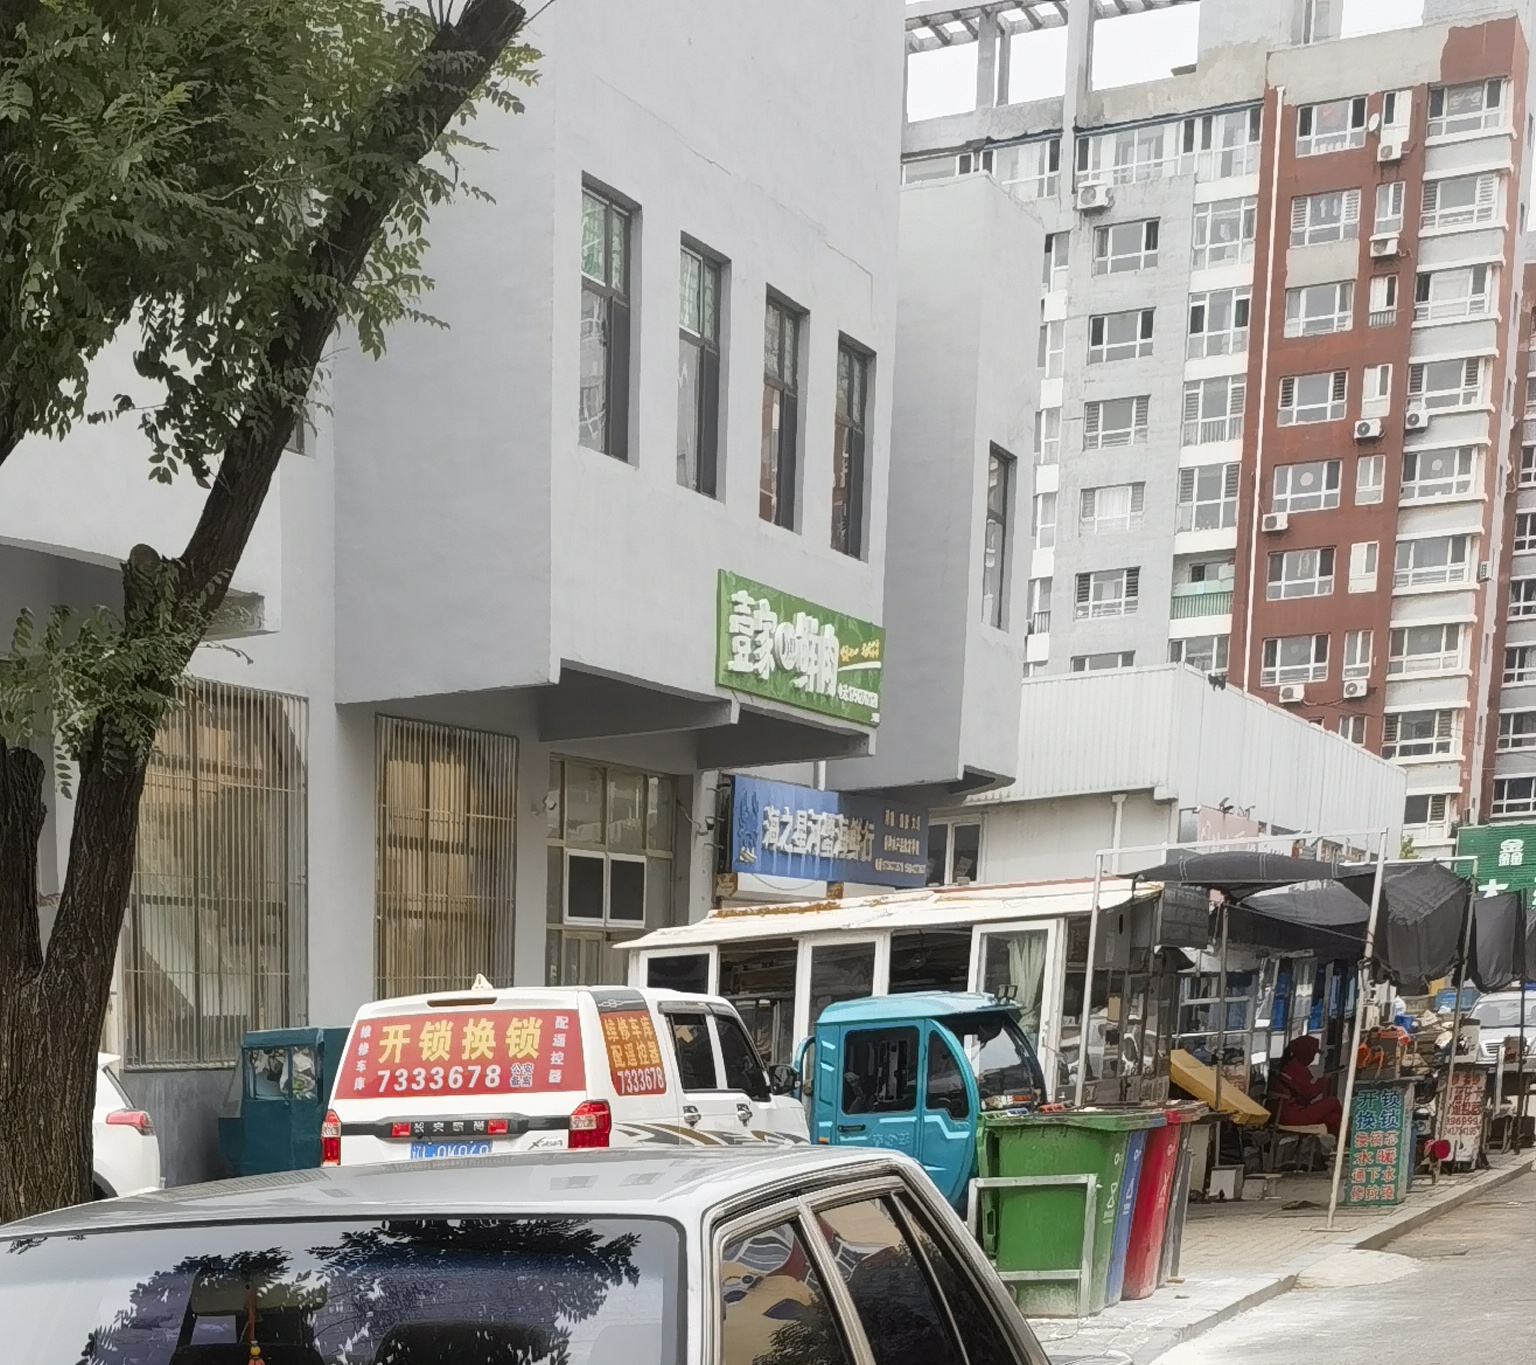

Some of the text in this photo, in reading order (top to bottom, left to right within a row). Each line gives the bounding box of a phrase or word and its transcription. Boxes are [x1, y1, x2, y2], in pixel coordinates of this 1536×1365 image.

[1498, 838, 1524, 866] 鑫
[378, 1017, 543, 1064] 开锁换锁
[377, 1064, 502, 1093] 7333678
[617, 1066, 665, 1095] 7333678
